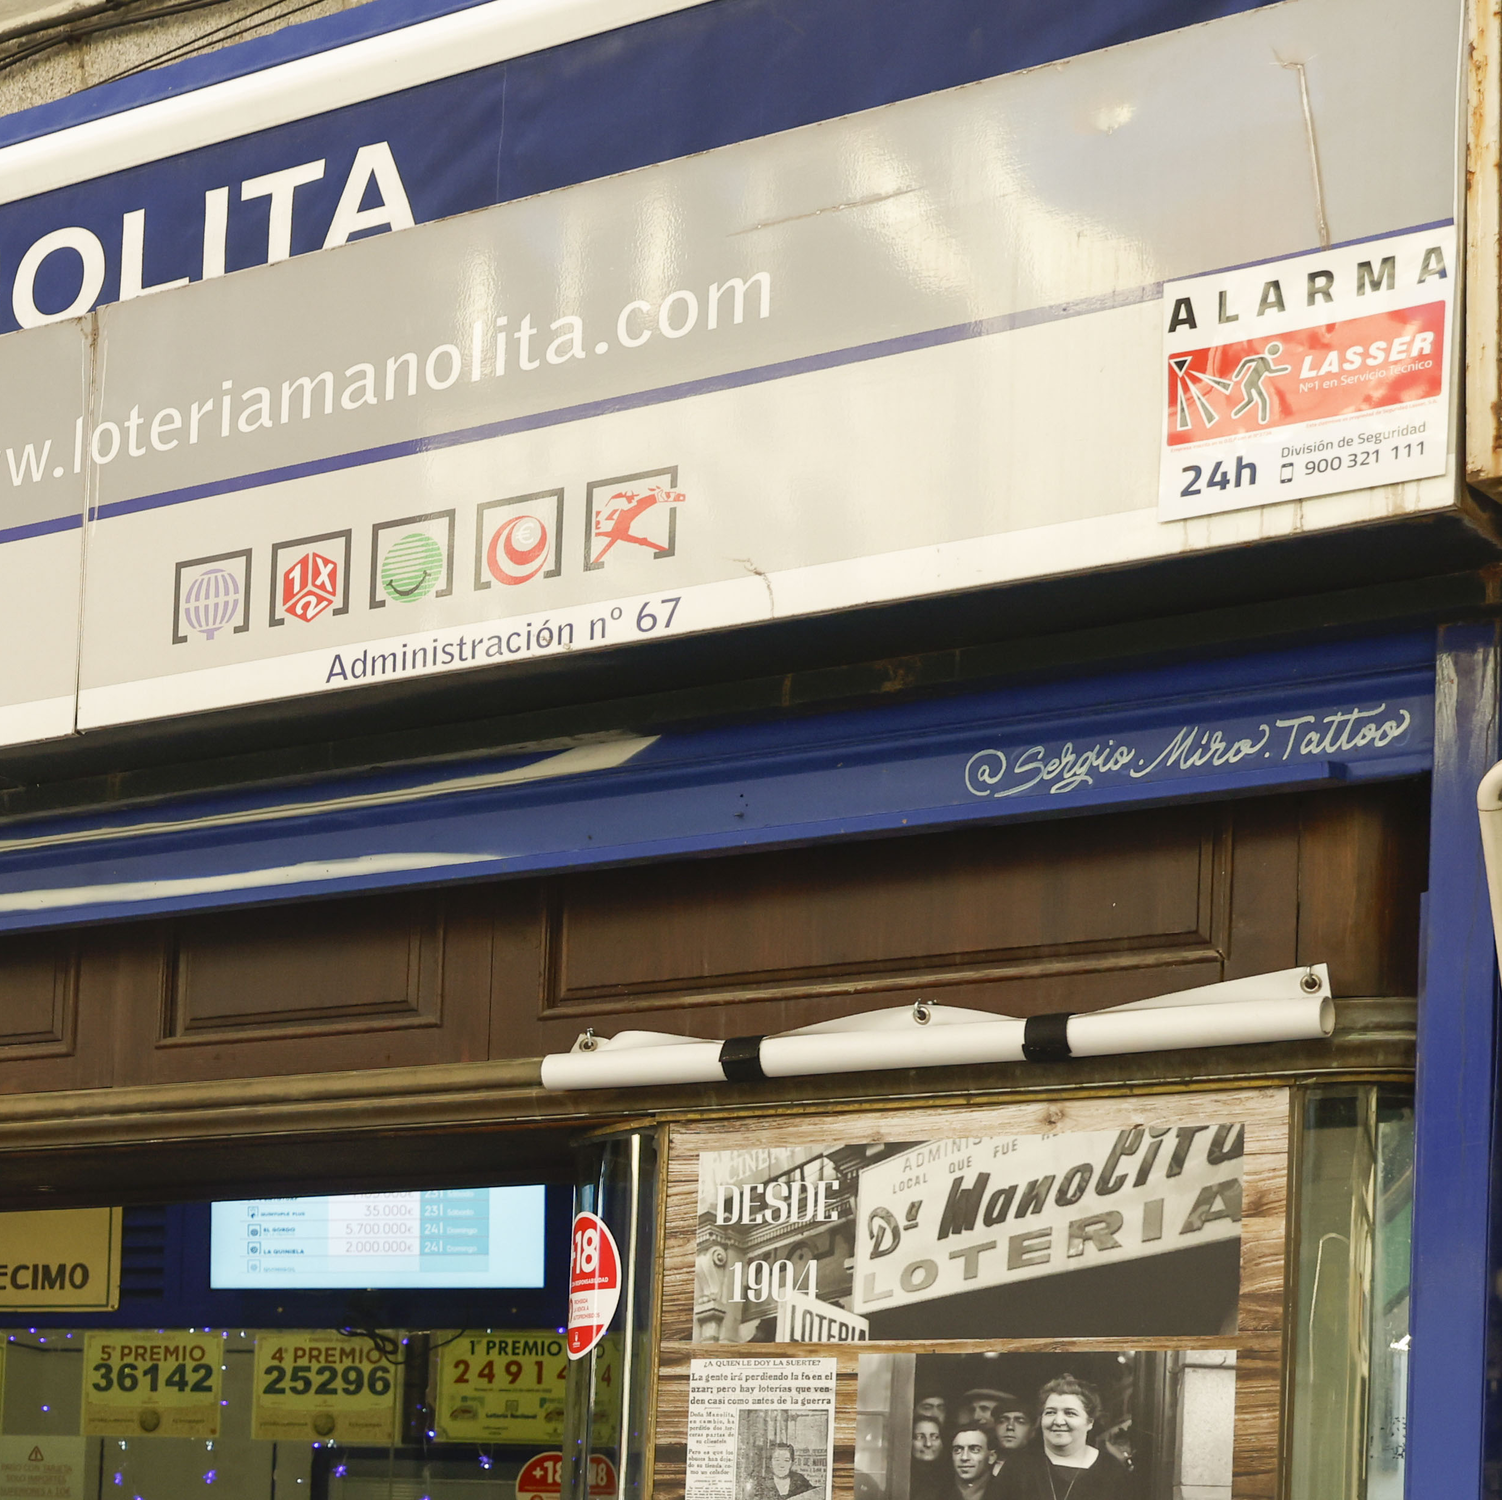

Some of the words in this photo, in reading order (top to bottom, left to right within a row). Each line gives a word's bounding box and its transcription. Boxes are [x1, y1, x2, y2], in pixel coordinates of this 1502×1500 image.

[1168, 246, 1447, 333] ALARMA
[1299, 331, 1435, 379] LASSER
[1323, 380, 1337, 389] en
[1340, 367, 1386, 385] Servicio
[1281, 440, 1334, 458] División
[1337, 436, 1354, 448] de
[1358, 422, 1426, 445] Seguridad
[1304, 456, 1342, 476] 900
[1347, 449, 1380, 468] 321
[1391, 441, 1425, 460] 111
[1180, 455, 1257, 497] 24h
[325, 617, 574, 684] Administración
[635, 596, 682, 633] 67
[892, 1172, 929, 1196] LOCAL
[948, 1155, 973, 1173] QUE
[993, 1138, 1018, 1159] FUE
[715, 1180, 840, 1226] DESDE
[345, 1223, 414, 1235] 5.700.000€
[862, 1177, 1242, 1304] LOTERIA
[345, 1241, 414, 1253] 2.000.000€
[728, 1259, 819, 1303] 1904
[120, 1345, 206, 1362] PREMIO
[293, 1347, 384, 1364] PREMIO
[486, 1340, 563, 1356] PREMIO
[92, 1363, 213, 1392] 36142
[263, 1365, 391, 1396] 25296
[691, 1373, 703, 1381] La
[705, 1374, 728, 1382] gente
[745, 1372, 788, 1382] perdiendo
[791, 1372, 799, 1380] la
[825, 1372, 833, 1380] el
[716, 1386, 736, 1394] pero
[739, 1385, 754, 1394] hay
[758, 1384, 792, 1393] loterías
[795, 1386, 811, 1394] que
[690, 1397, 705, 1405] den
[707, 1397, 725, 1405] casi
[790, 1396, 799, 1404] la
[801, 1398, 831, 1406] guerra
